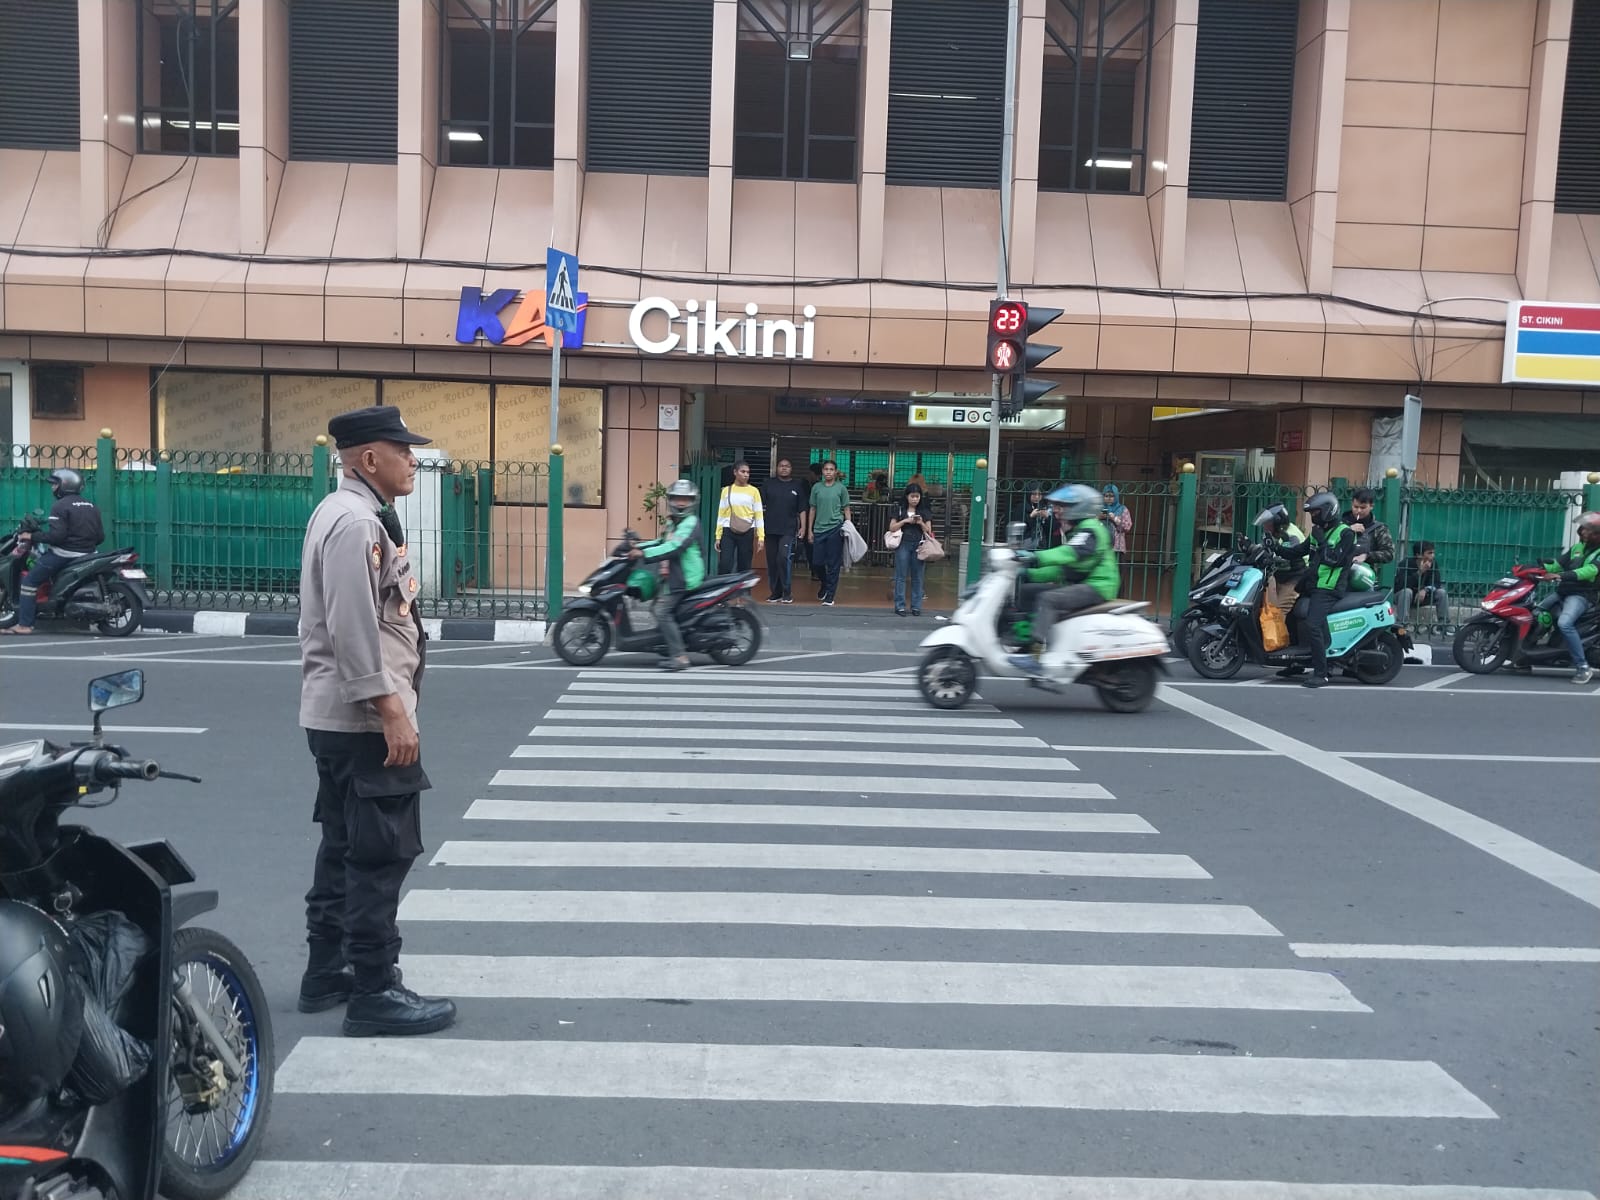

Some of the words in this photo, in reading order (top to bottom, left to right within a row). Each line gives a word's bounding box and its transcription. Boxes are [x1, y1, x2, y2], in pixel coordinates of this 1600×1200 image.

[456, 286, 588, 349] KAI
[629, 296, 816, 359] Cikini
[996, 309, 1020, 330] 23
[1521, 315, 1534, 324] ST.
[1536, 316, 1563, 326] CIKINI
[983, 411, 1021, 424] Ckini
